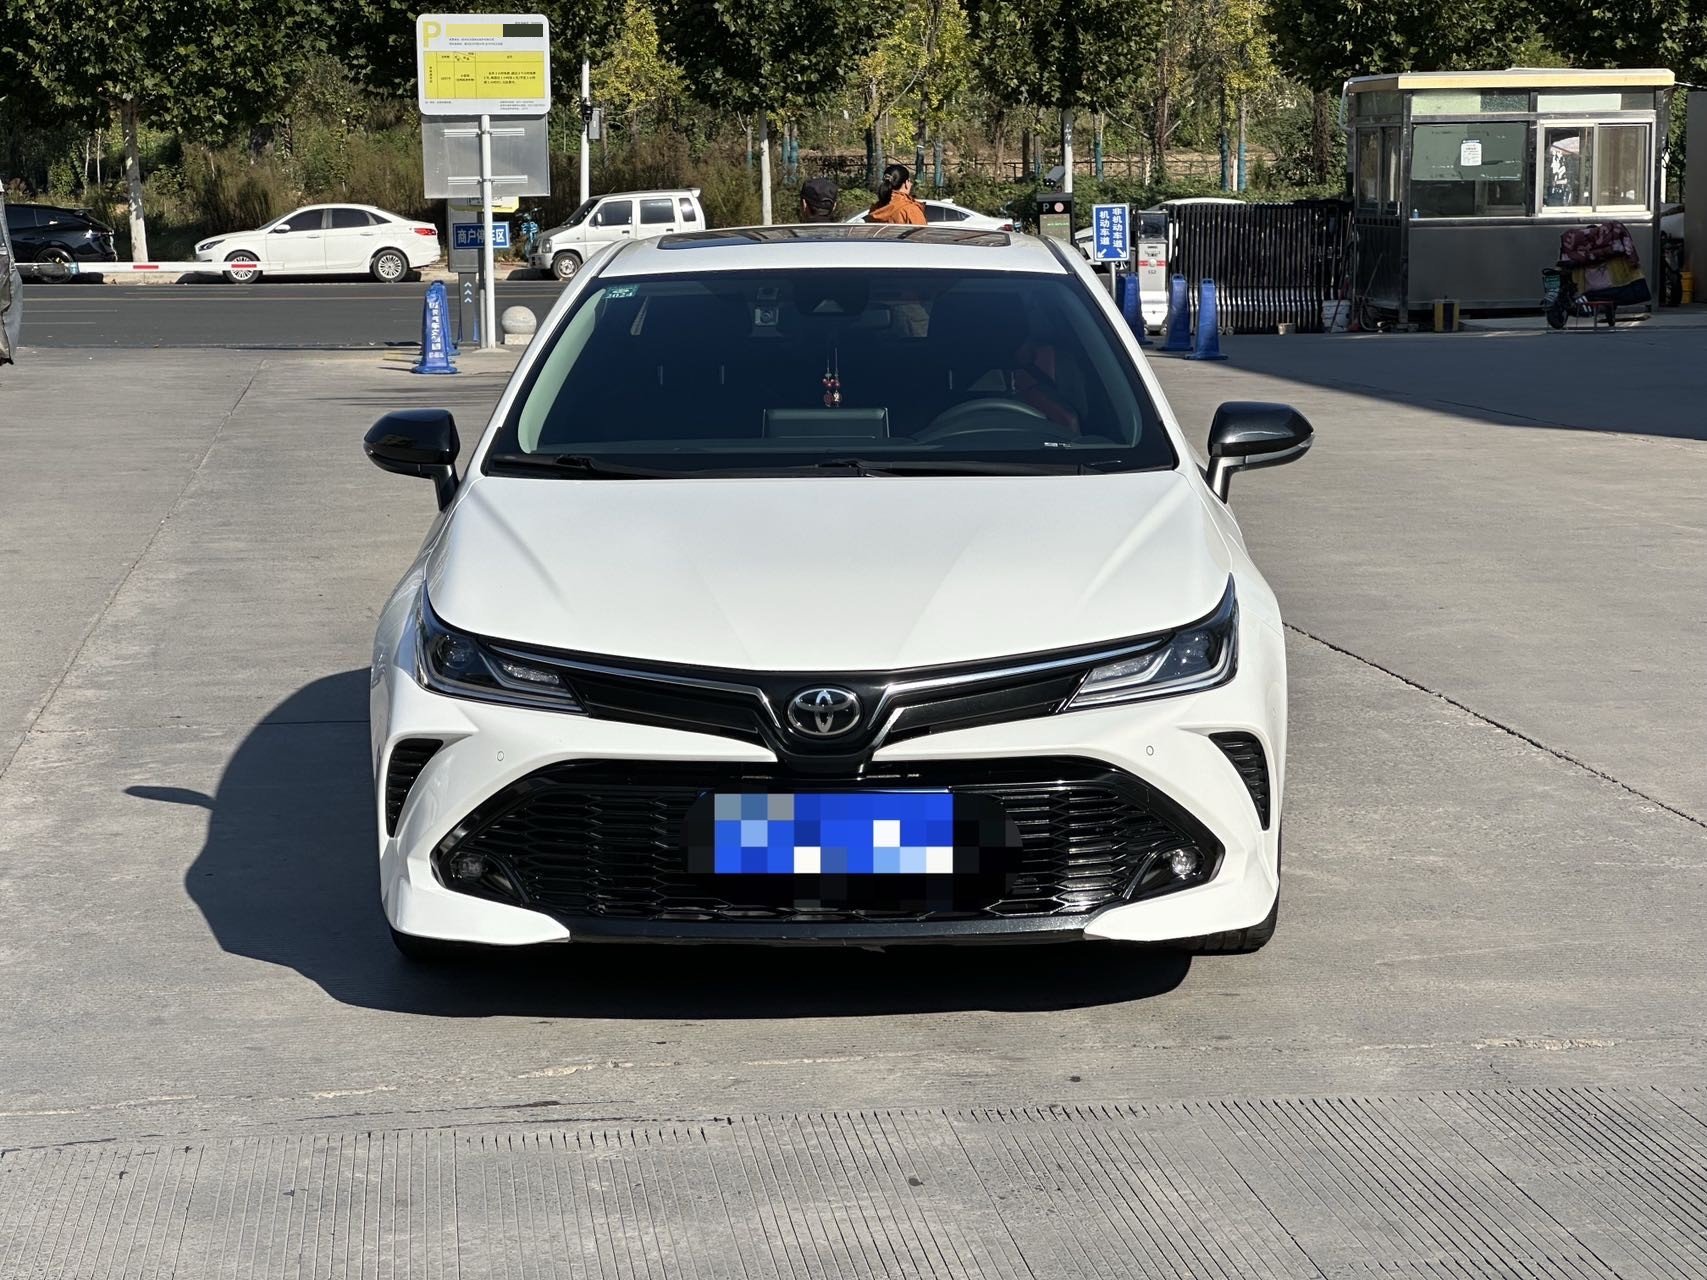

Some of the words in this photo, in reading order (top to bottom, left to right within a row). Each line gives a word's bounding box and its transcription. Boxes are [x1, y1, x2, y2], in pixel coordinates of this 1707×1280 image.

[422, 21, 442, 48] P
[457, 229, 505, 243] 商户停区
[1100, 210, 1110, 246] 机动车道
[1112, 208, 1123, 248] 非机动车道
